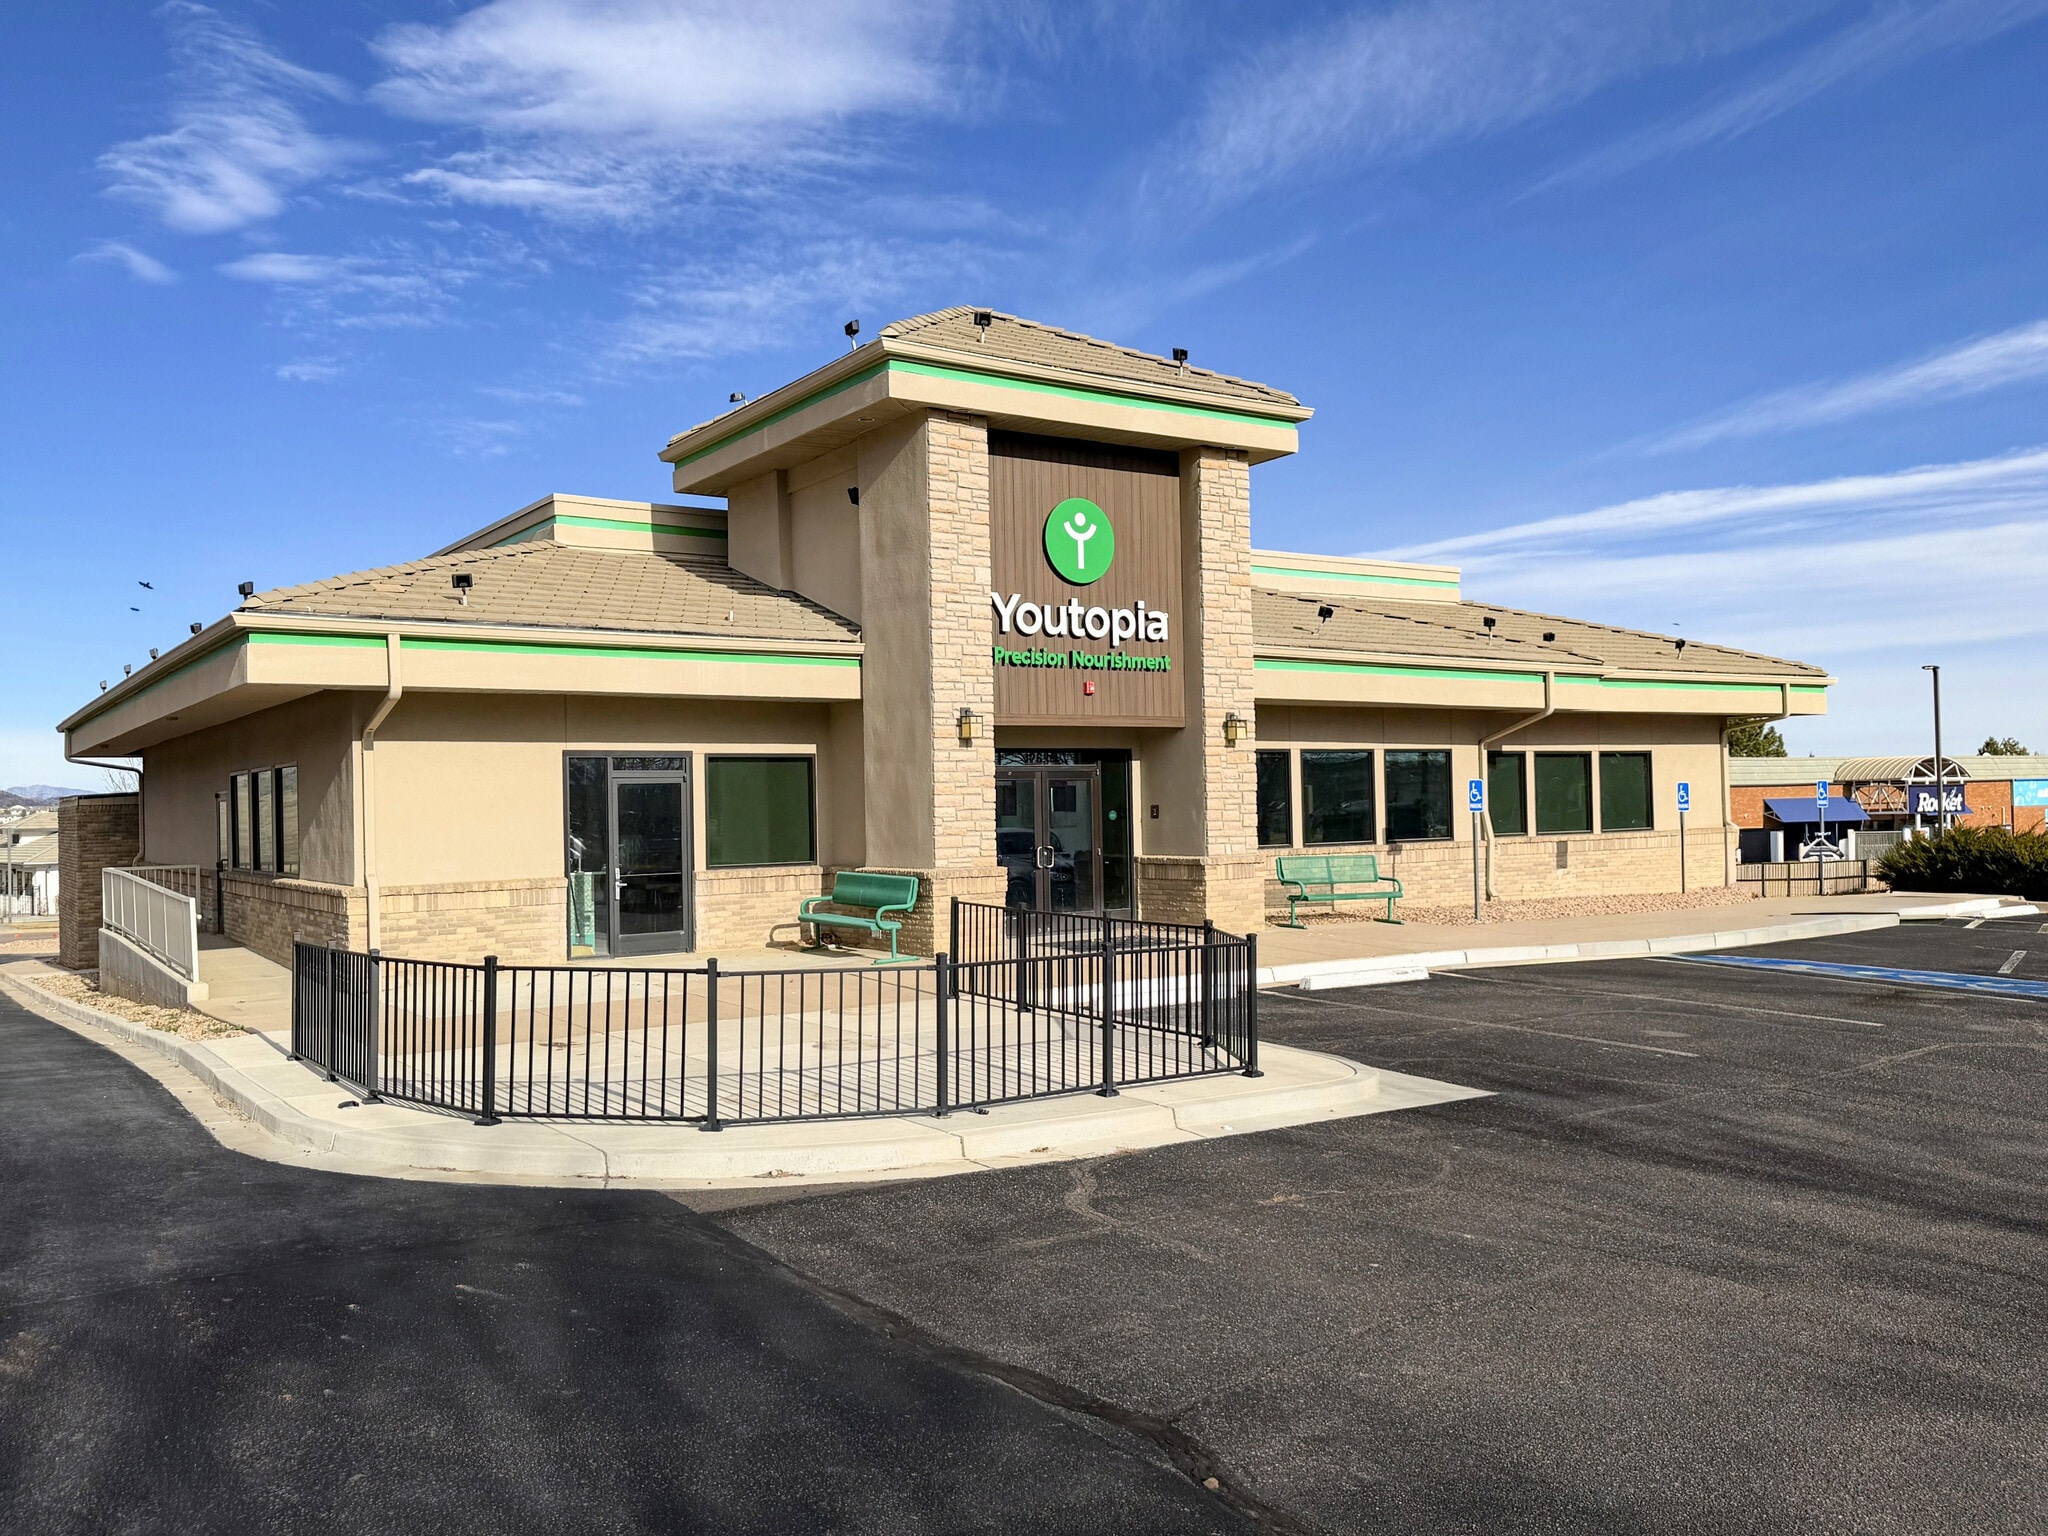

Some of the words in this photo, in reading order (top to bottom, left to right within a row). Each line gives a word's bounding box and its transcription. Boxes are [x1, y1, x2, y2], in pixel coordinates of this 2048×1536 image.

[991, 591, 1169, 646] Youtopia
[994, 646, 1068, 667] Precision
[1073, 650, 1171, 671] Nourishment
[1917, 791, 1963, 812] Roket
